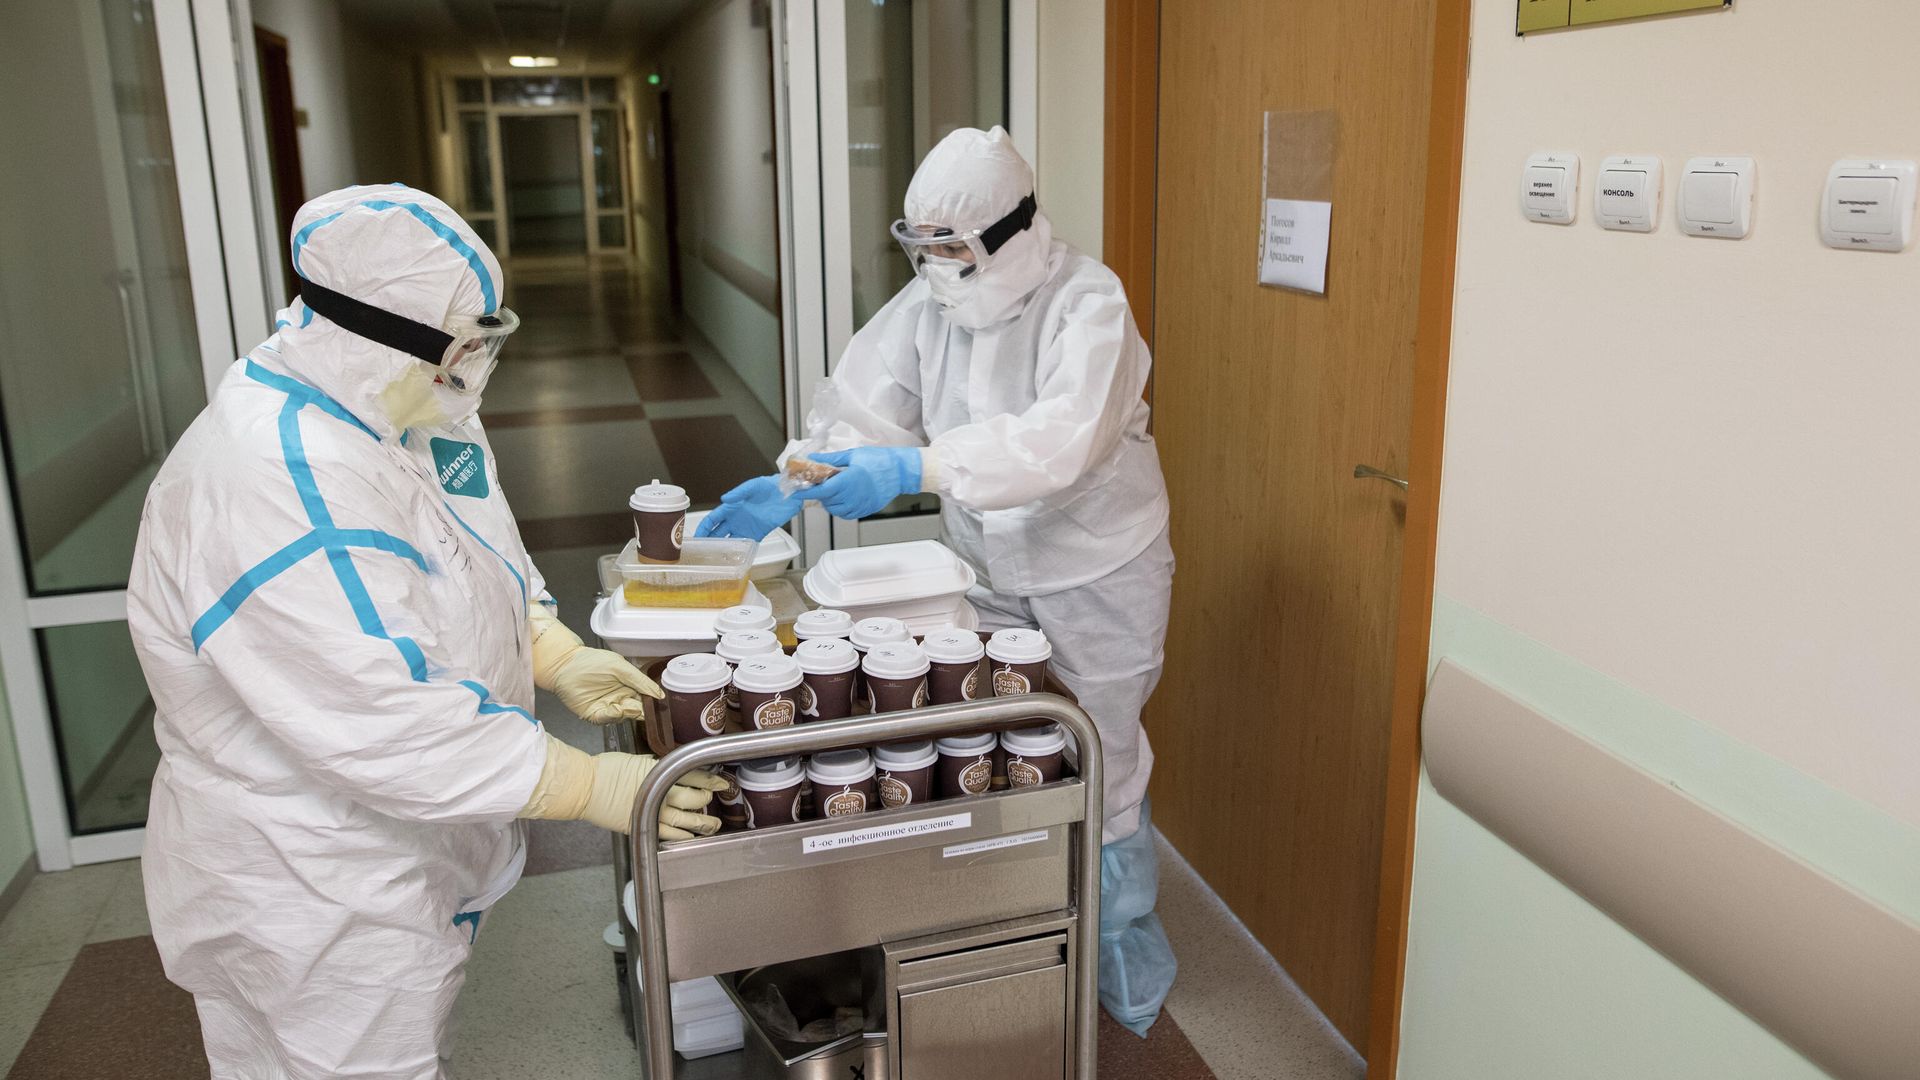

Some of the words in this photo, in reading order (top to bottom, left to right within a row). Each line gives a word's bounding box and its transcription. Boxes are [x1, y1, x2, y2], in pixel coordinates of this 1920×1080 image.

[1528, 191, 1556, 199] освещение
[440, 444, 474, 485] winner
[998, 677, 1021, 688] Taste
[995, 682, 1025, 695] Quality
[764, 708, 790, 719] Taste
[759, 714, 792, 726] Quality
[833, 800, 860, 810] Taste
[810, 840, 816, 848] 4
[838, 826, 907, 844] инфекционное
[907, 819, 954, 833] отделение
